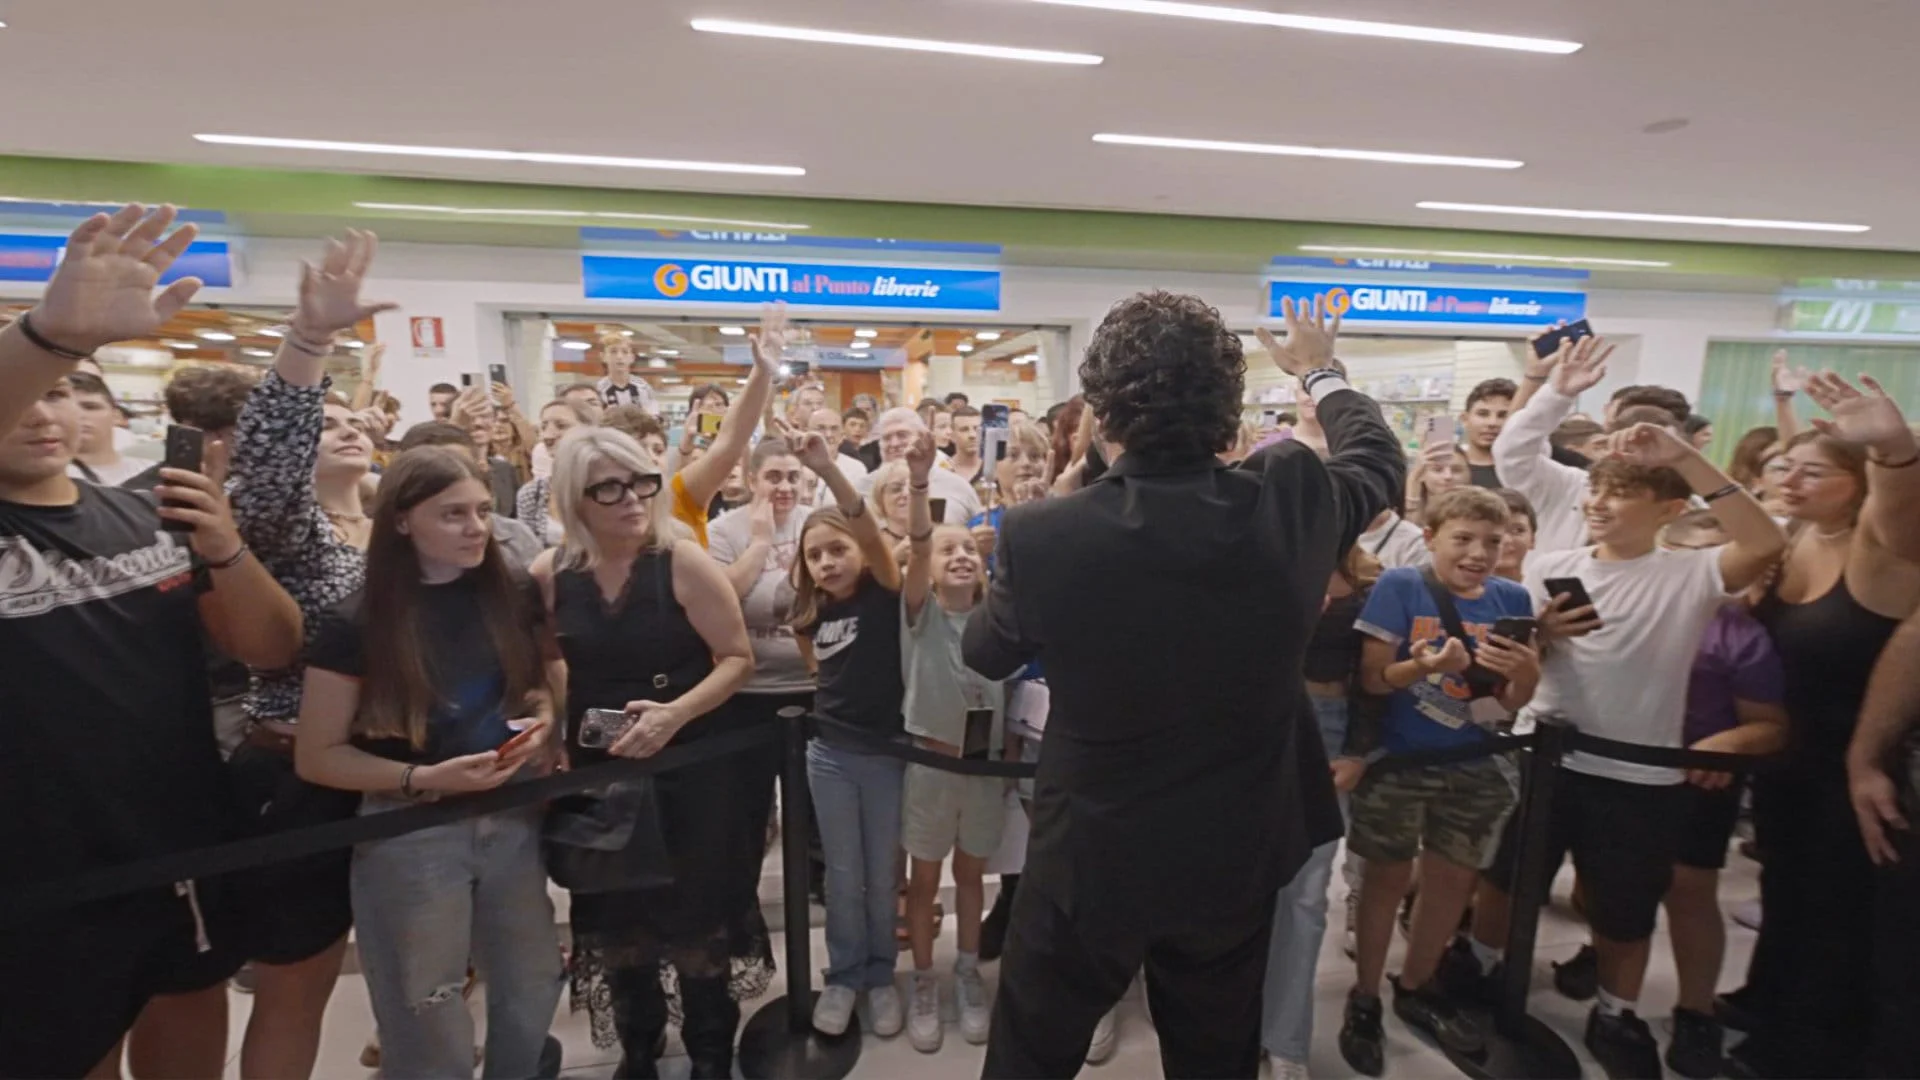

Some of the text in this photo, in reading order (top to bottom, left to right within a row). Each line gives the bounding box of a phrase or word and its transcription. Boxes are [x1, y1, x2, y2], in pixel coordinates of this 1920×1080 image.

[690, 264, 940, 297] GIUNTI al Punto librerie
[1352, 287, 1427, 312] GIUNTI
[816, 616, 860, 643] NIKE
